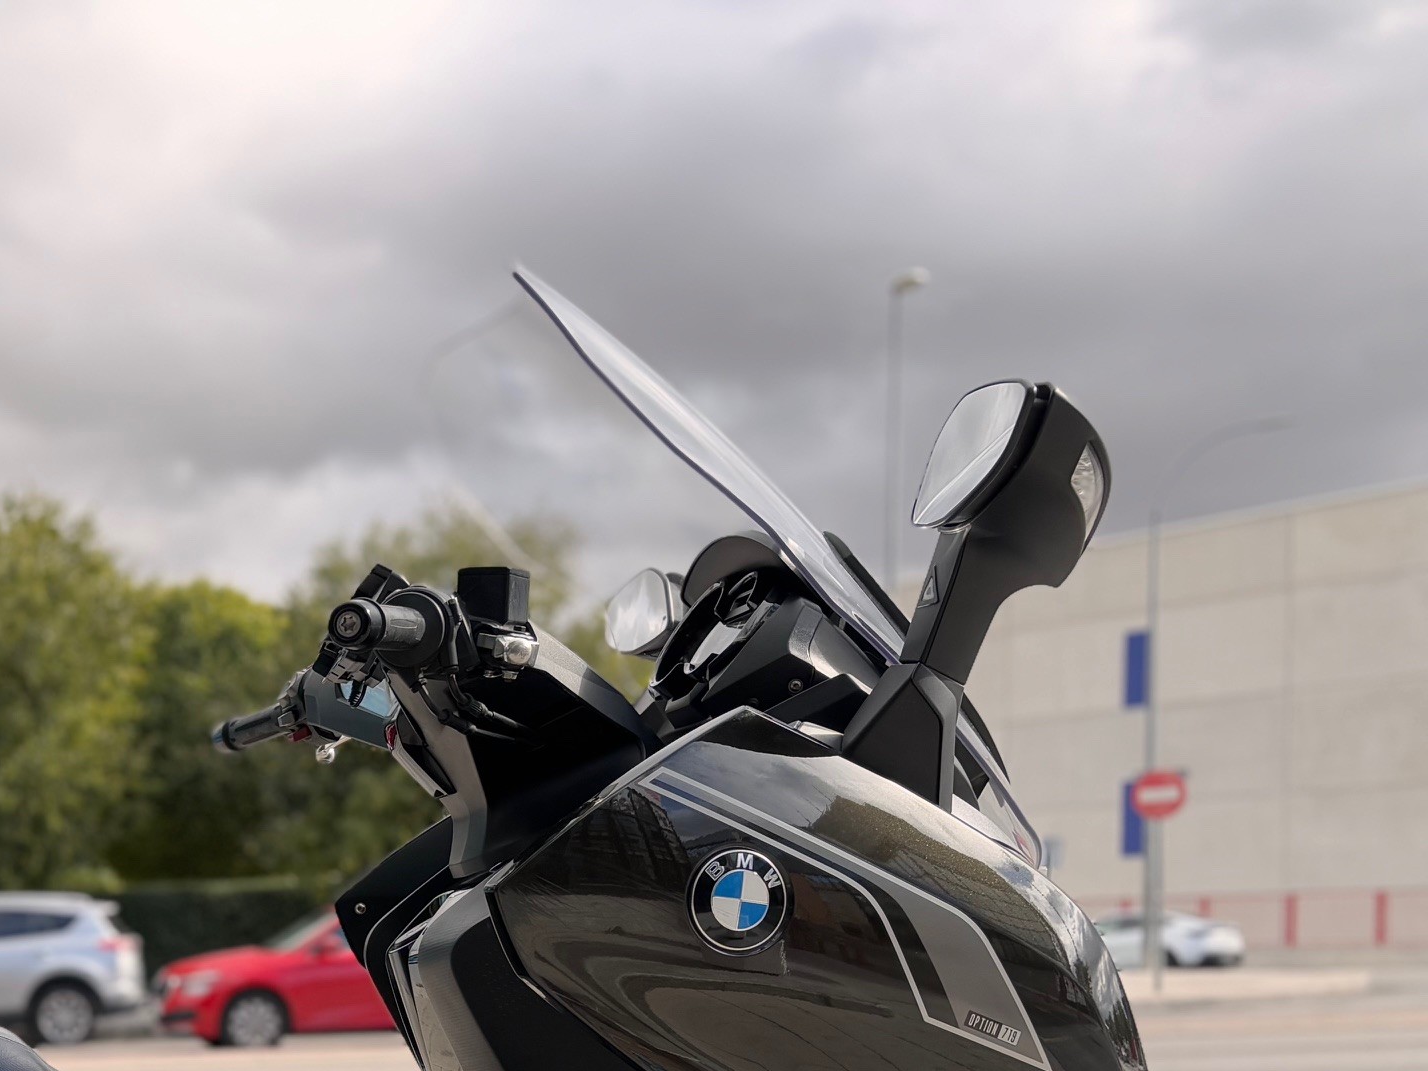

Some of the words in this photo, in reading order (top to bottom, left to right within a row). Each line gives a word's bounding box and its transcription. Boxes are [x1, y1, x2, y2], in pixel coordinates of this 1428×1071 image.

[705, 852, 781, 889] BMW
[968, 1013, 999, 1036] OPTION
[1001, 1027, 1018, 1043] 719
